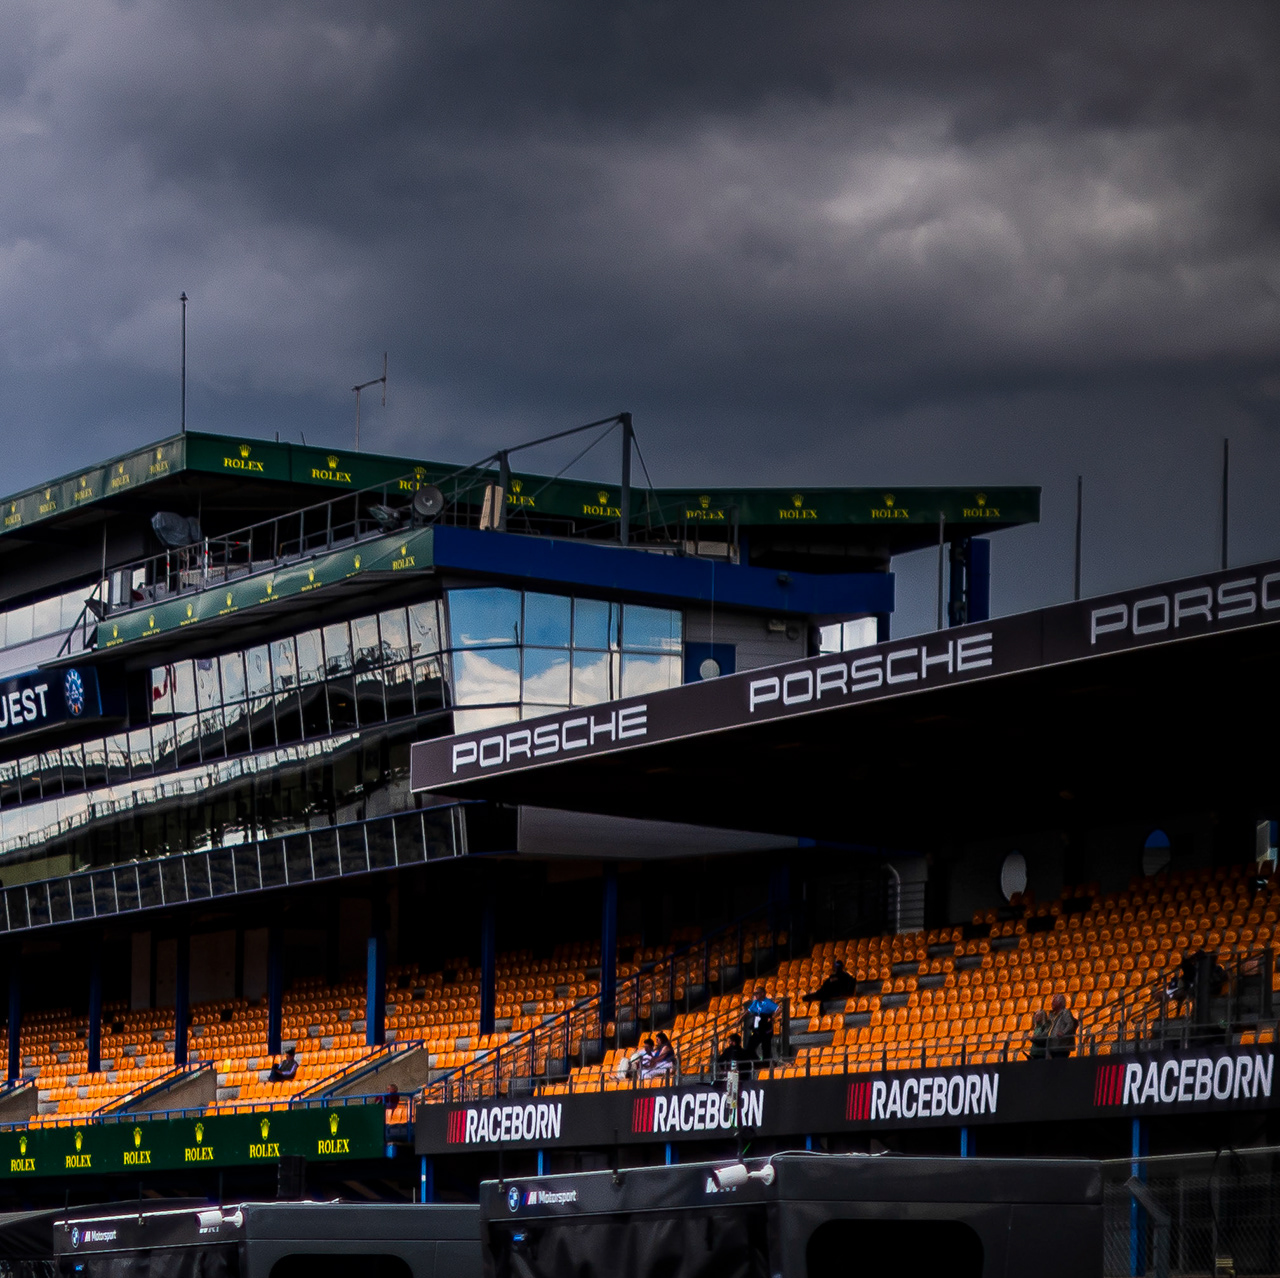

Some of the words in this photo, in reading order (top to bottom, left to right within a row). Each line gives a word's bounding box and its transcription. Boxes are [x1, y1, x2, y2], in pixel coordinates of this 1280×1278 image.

[150, 461, 169, 474] ROLEX
[223, 457, 264, 472] ROLEX
[111, 474, 130, 488] ROLEX
[311, 468, 352, 483] ROLEX
[506, 494, 535, 507] OLEX
[583, 505, 622, 518] ROLEX
[779, 509, 818, 519] ROLEX
[871, 508, 909, 518] ROLEX
[963, 507, 1001, 517] ROLEX
[392, 556, 416, 570] ROLEX
[749, 632, 994, 712] PORSCHE
[451, 704, 648, 774] PORSCHE
[1122, 1053, 1275, 1105] RACEBORN
[870, 1073, 1000, 1121] RACEBORN
[653, 1089, 765, 1133] RACEBORN
[465, 1103, 562, 1144] RACEBORN
[249, 1143, 280, 1158] ROLEX
[317, 1138, 350, 1154] ROLEX
[65, 1154, 92, 1168] ROLEX
[123, 1150, 151, 1165] ROLEX
[184, 1147, 214, 1161] ROLEX
[10, 1158, 36, 1172] ROLEX
[538, 1190, 577, 1206] Motorsport
[91, 1229, 117, 1243] Motorsport
